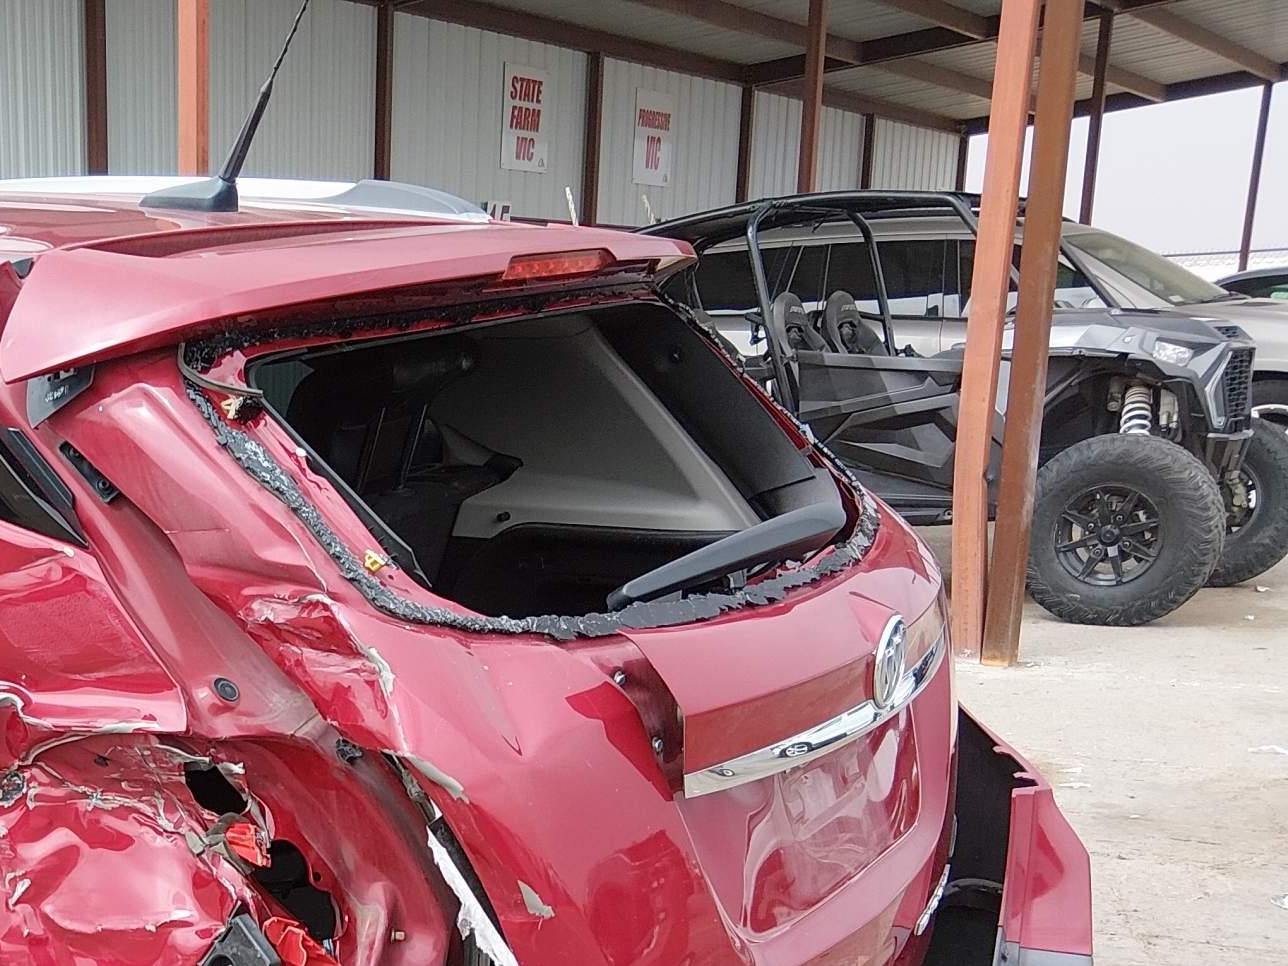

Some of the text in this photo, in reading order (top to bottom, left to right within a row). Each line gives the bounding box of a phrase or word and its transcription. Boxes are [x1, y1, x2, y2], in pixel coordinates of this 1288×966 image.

[510, 75, 543, 104] STATE
[510, 105, 540, 132] FARM
[638, 108, 671, 131] PROGRESSIVE
